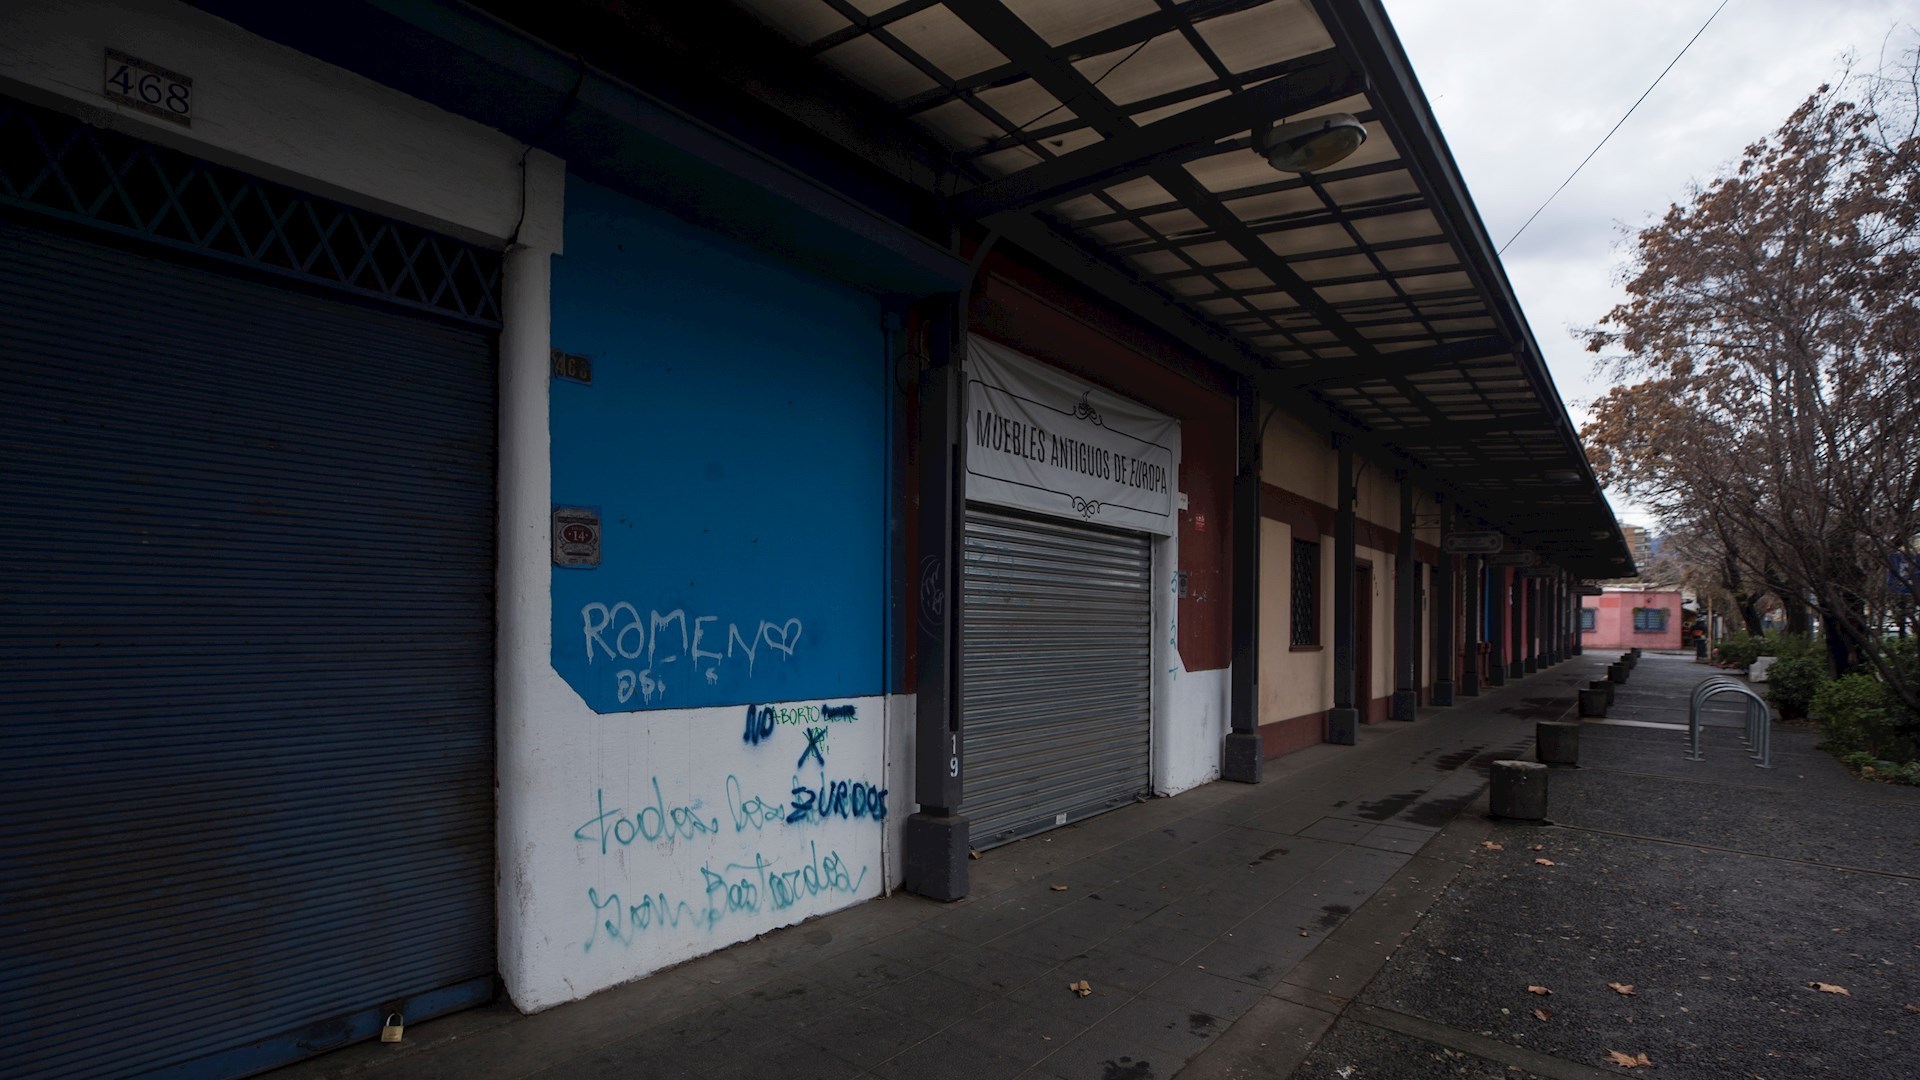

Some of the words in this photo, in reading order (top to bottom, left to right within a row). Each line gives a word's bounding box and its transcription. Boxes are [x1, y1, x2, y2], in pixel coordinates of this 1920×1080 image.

[108, 66, 189, 113] 468
[976, 410, 1045, 463] MUEBLES
[1051, 434, 1110, 480] ANTIGUOS
[1114, 453, 1127, 485] DE
[1129, 459, 1167, 494] EUROPA
[743, 704, 774, 745] NO
[770, 706, 820, 725] ABORTO
